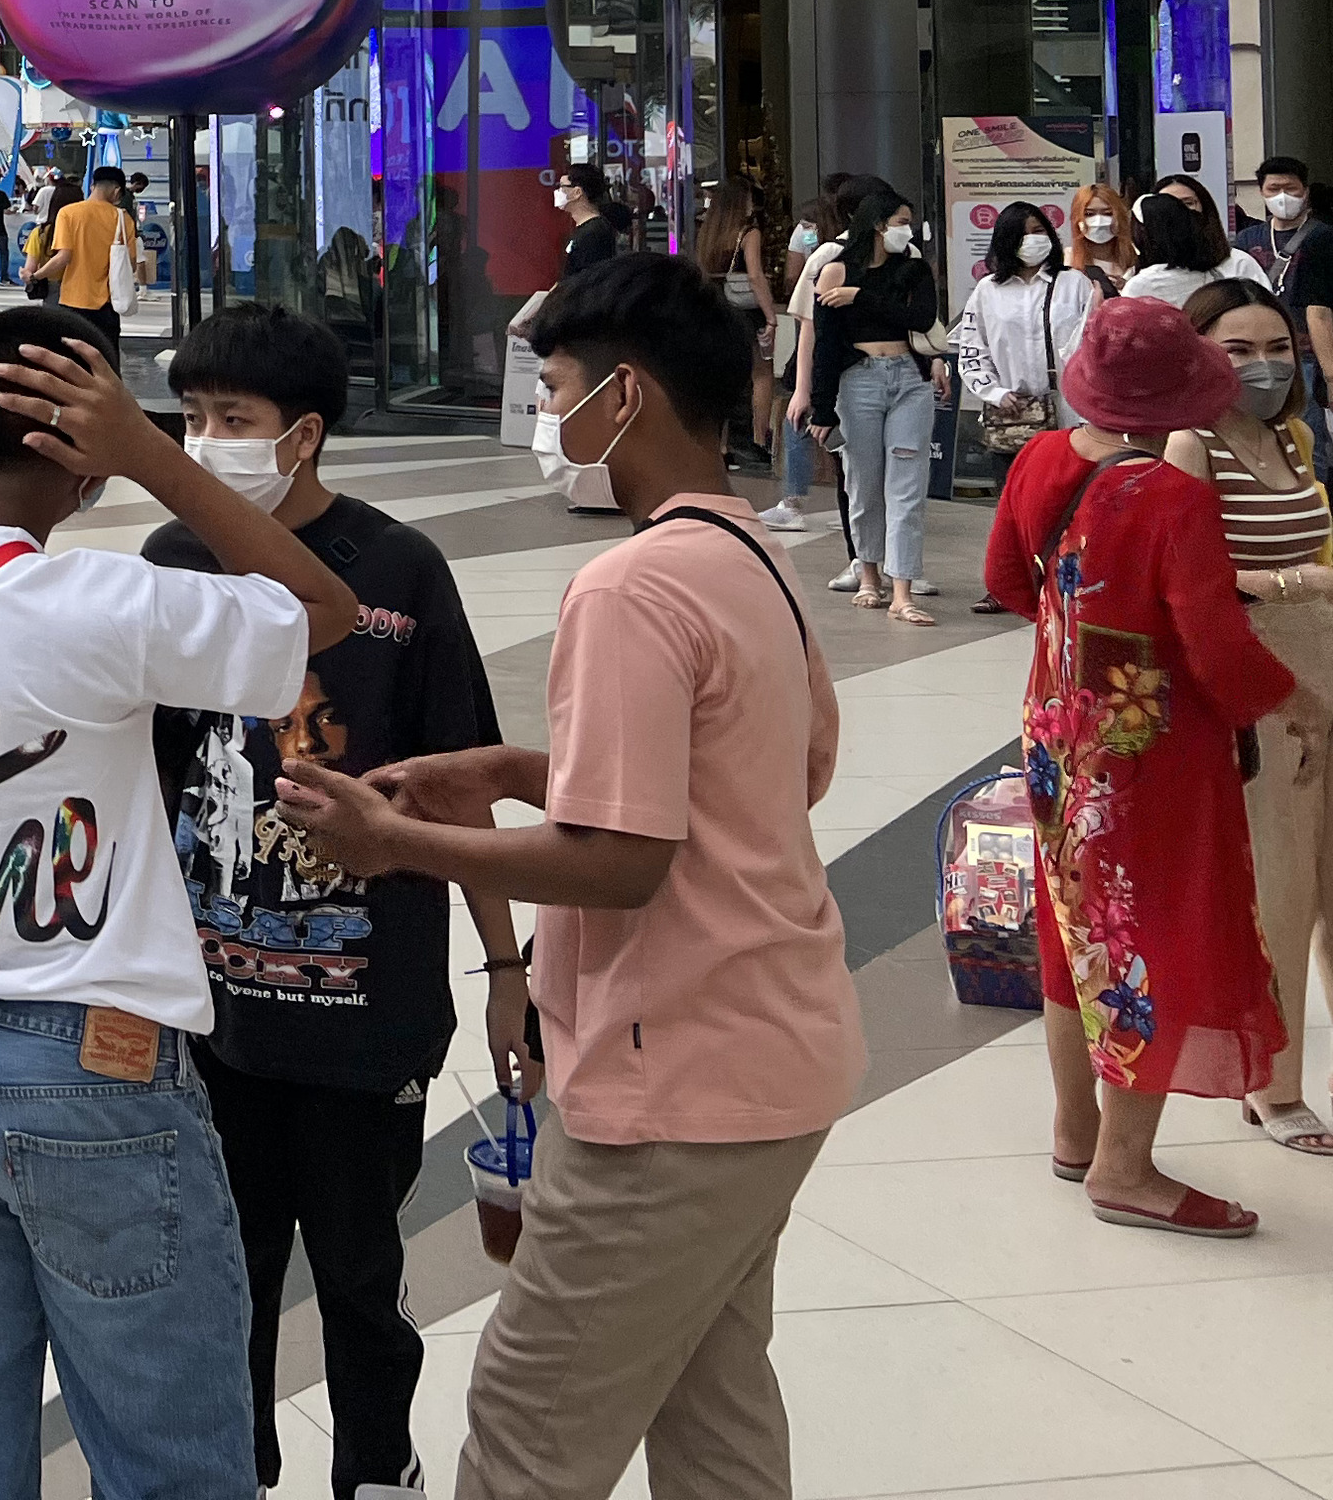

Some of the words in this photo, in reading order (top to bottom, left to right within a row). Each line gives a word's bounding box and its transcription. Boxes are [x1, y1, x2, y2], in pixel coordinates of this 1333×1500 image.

[58, 11, 76, 19] THE
[81, 12, 139, 21] PARALLEL
[145, 10, 189, 20] WORLD
[196, 8, 211, 17] OF
[49, 21, 142, 31] EXTRAORDINARY
[147, 18, 232, 31] EXPERIENCES
[958, 128, 981, 138] ONE
[984, 122, 1018, 134] SMILE
[209, 969, 224, 982] to
[226, 982, 272, 1000] nyone
[276, 989, 304, 1003] but
[310, 993, 369, 1007] myself.
